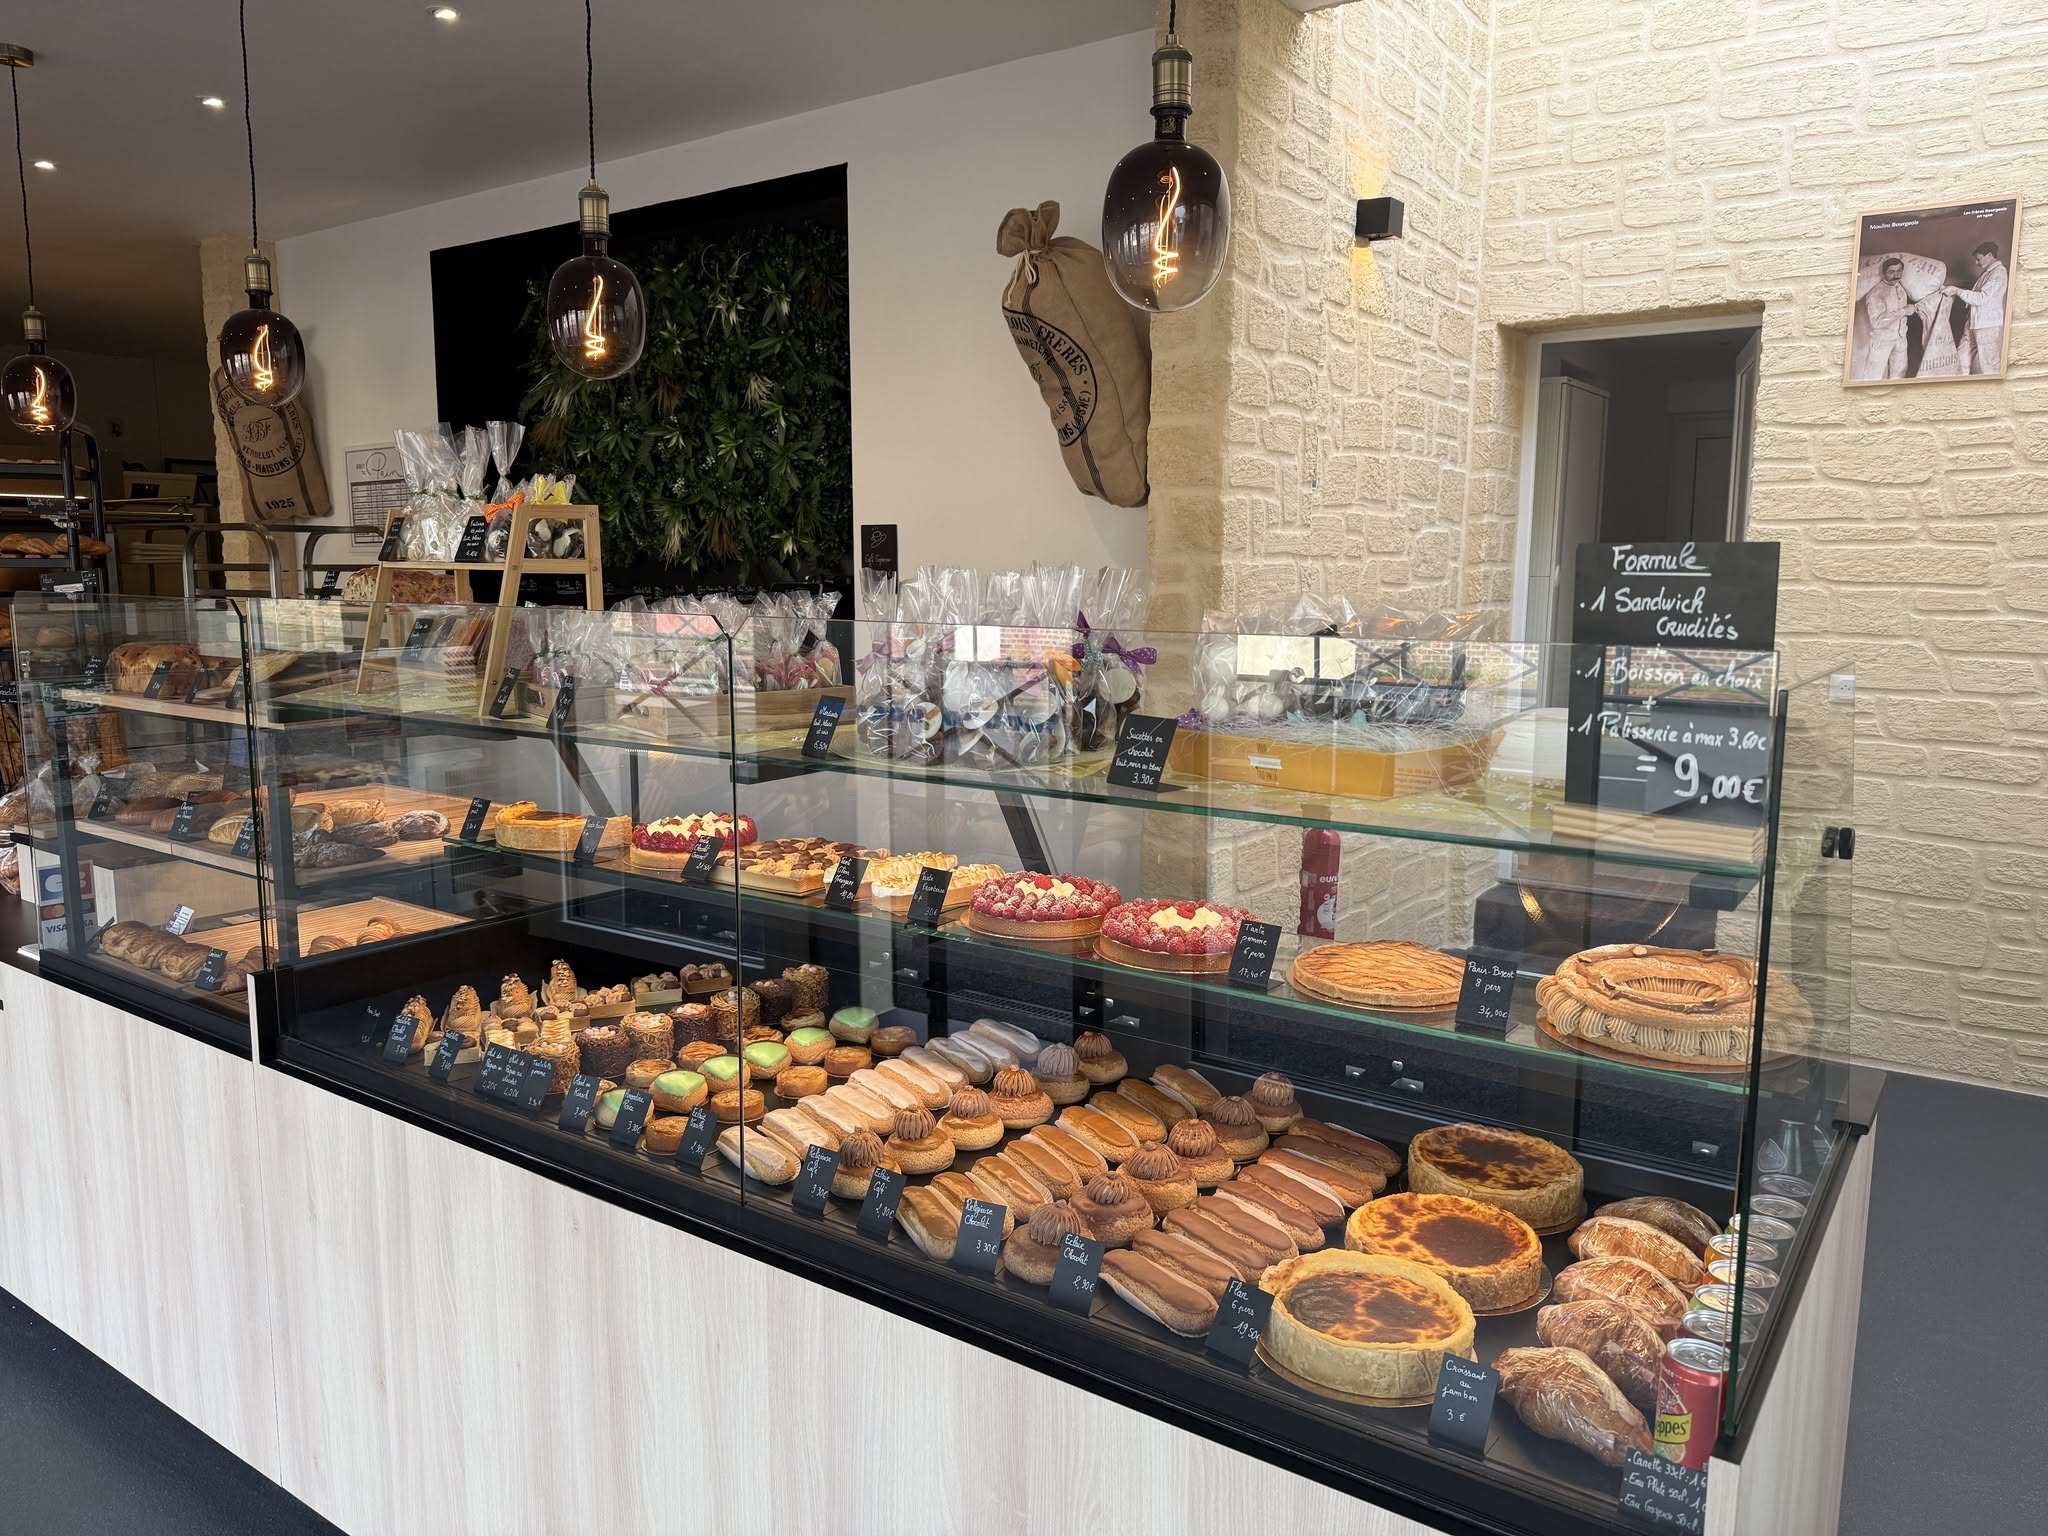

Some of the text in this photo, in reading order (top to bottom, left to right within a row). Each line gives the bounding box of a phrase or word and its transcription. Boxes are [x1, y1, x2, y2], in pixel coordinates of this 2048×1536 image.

[1892, 220, 1920, 228] Bourgeois
[1037, 325, 1088, 376] FRERES
[264, 497, 296, 511] 1925
[1590, 585, 1706, 614] 1 Sandwich
[1656, 613, 1739, 640] Crudités
[1585, 657, 1763, 690] 1 Boisson au choix
[1127, 728, 1152, 742] Sucettes
[1577, 713, 1593, 737] 1
[1682, 721, 1694, 744] à
[1694, 732, 1724, 748] max
[1128, 746, 1155, 758] chocolat
[1244, 923, 1265, 936] Tarte
[1240, 936, 1268, 946] pomme
[1475, 978, 1502, 994] 8 pers
[965, 1198, 994, 1218] Religieuse
[964, 1214, 990, 1230] Chocolat
[976, 1239, 998, 1255] 3,30€
[1064, 1246, 1089, 1266] Chocolat
[1228, 1280, 1249, 1300] Flan
[1231, 1299, 1255, 1316] 6 pers
[1446, 1359, 1487, 1380] Croissant
[1442, 1383, 1478, 1402] jambon
[1459, 1380, 1472, 1389] au
[1446, 1408, 1467, 1422] 3 €
[1632, 1450, 1663, 1473] Canette
[1628, 1472, 1645, 1488] Eau
[1646, 1475, 1666, 1496] Plate
[1624, 1493, 1641, 1510] Eau
